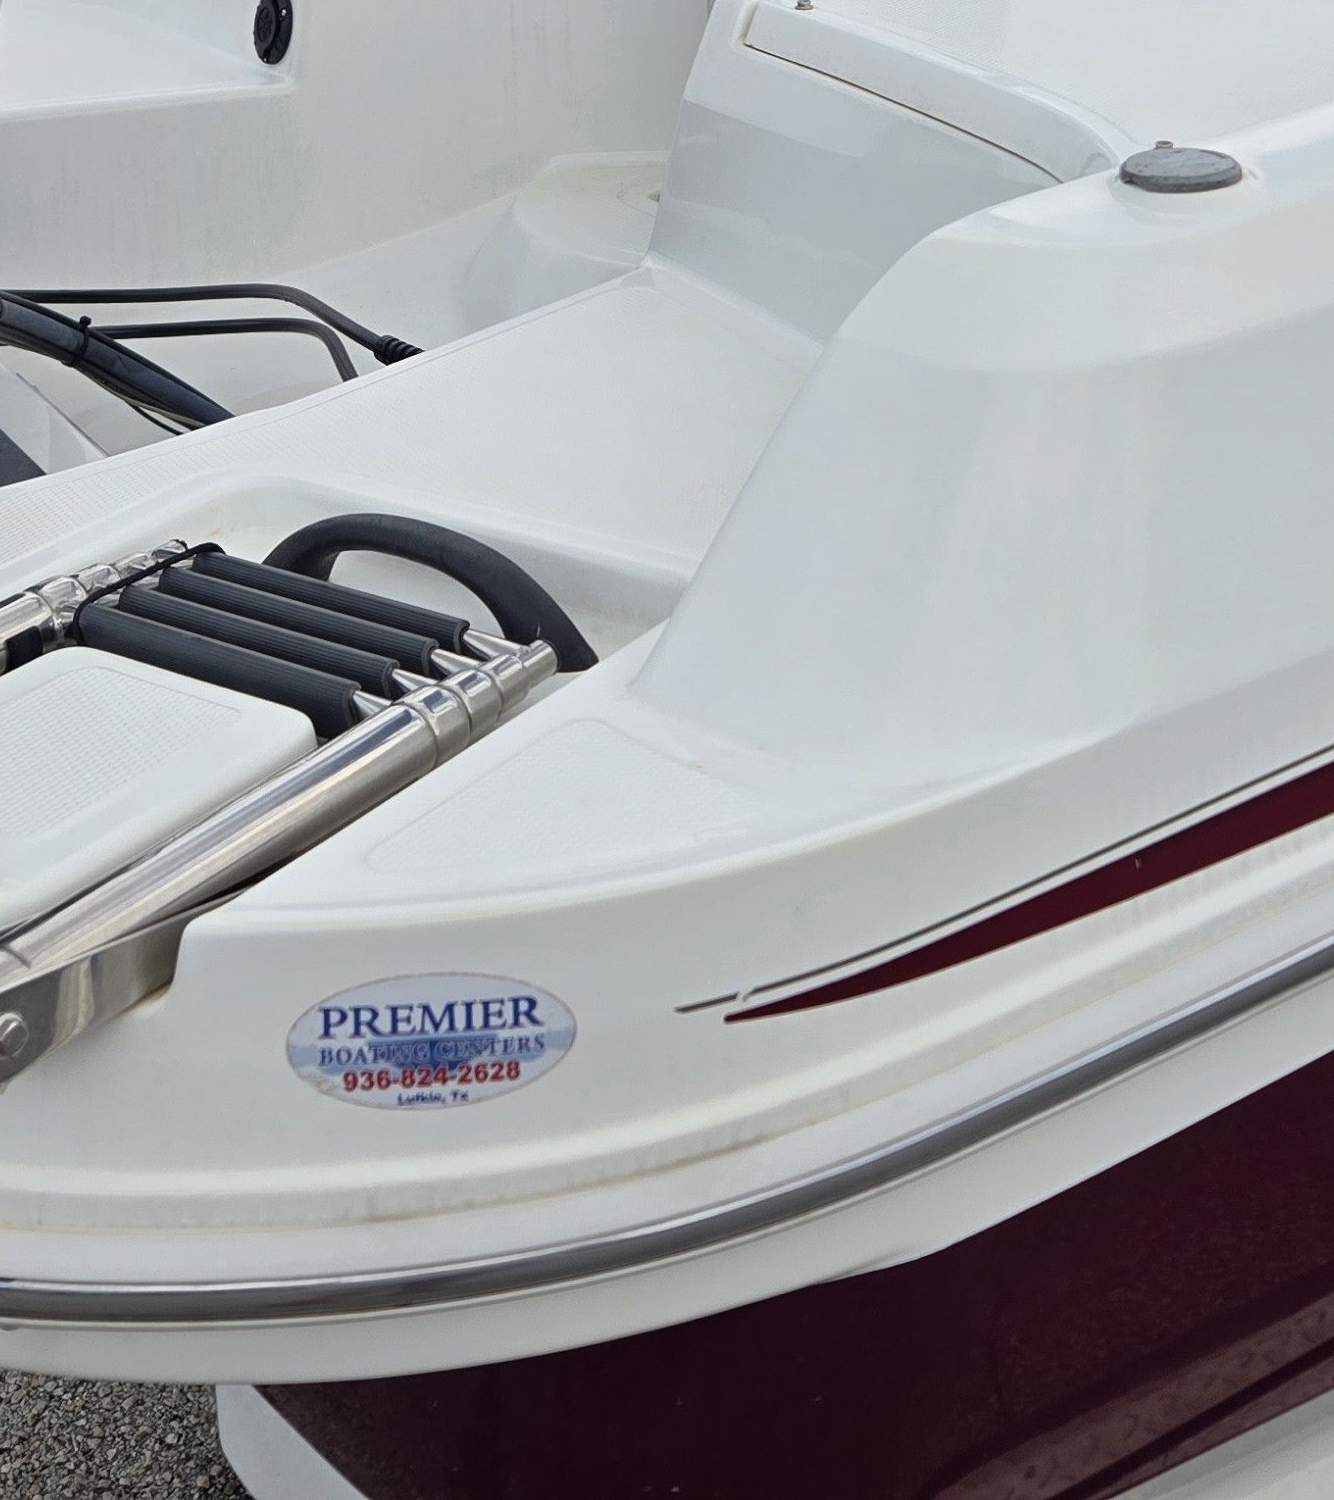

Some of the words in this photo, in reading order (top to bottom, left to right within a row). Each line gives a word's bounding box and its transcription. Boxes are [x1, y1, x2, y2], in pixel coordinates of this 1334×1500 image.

[317, 994, 545, 1041] PREMIER
[318, 1041, 430, 1068] BOATING
[432, 1033, 546, 1061] CENTERS
[343, 1060, 521, 1093] 936-824-2628
